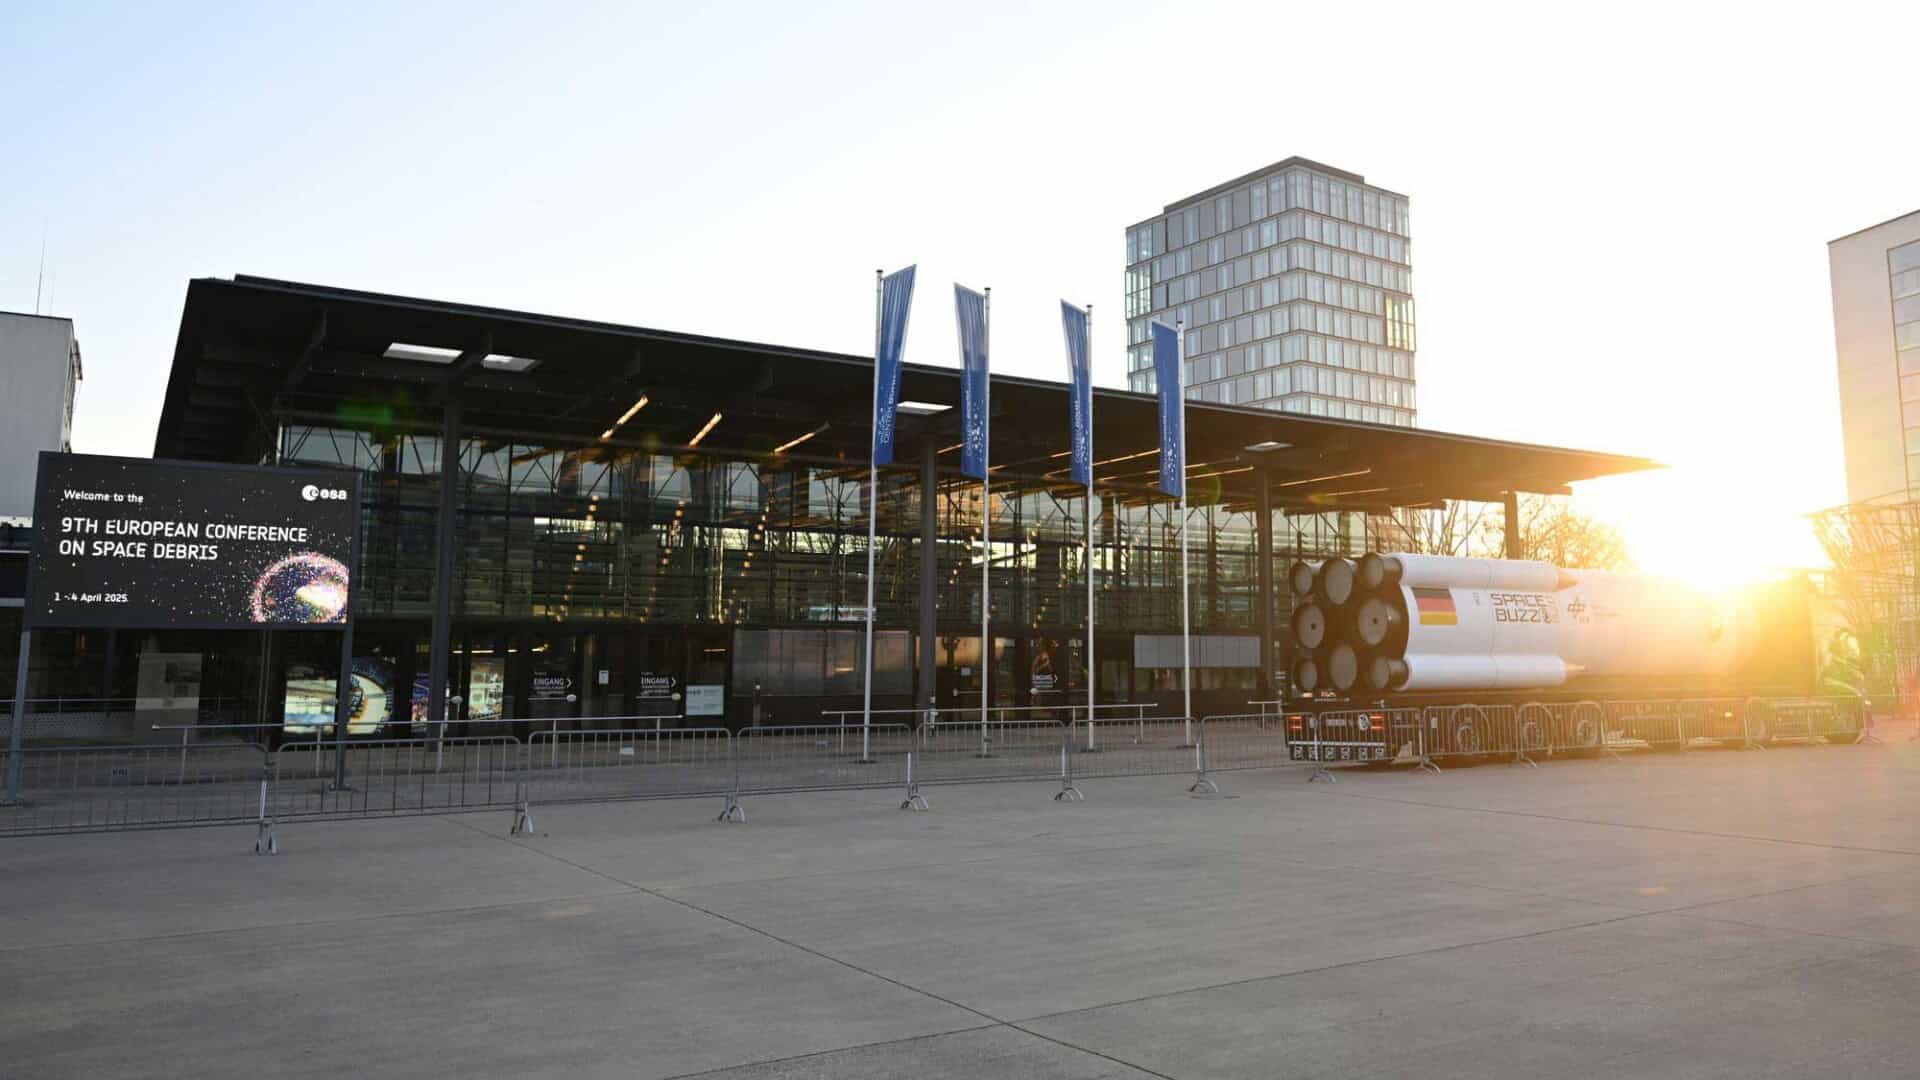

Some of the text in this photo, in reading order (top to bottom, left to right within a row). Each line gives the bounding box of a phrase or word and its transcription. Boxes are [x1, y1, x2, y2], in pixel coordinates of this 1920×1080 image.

[64, 489, 144, 503] Welcome to the
[61, 517, 308, 542] 9TH EUROPEAN CONFERENCE
[59, 540, 218, 560] ON SPACE DEBRIS
[70, 593, 78, 601] 4
[81, 592, 102, 603] April
[104, 593, 128, 602] 2025
[1490, 593, 1547, 607] SPACE
